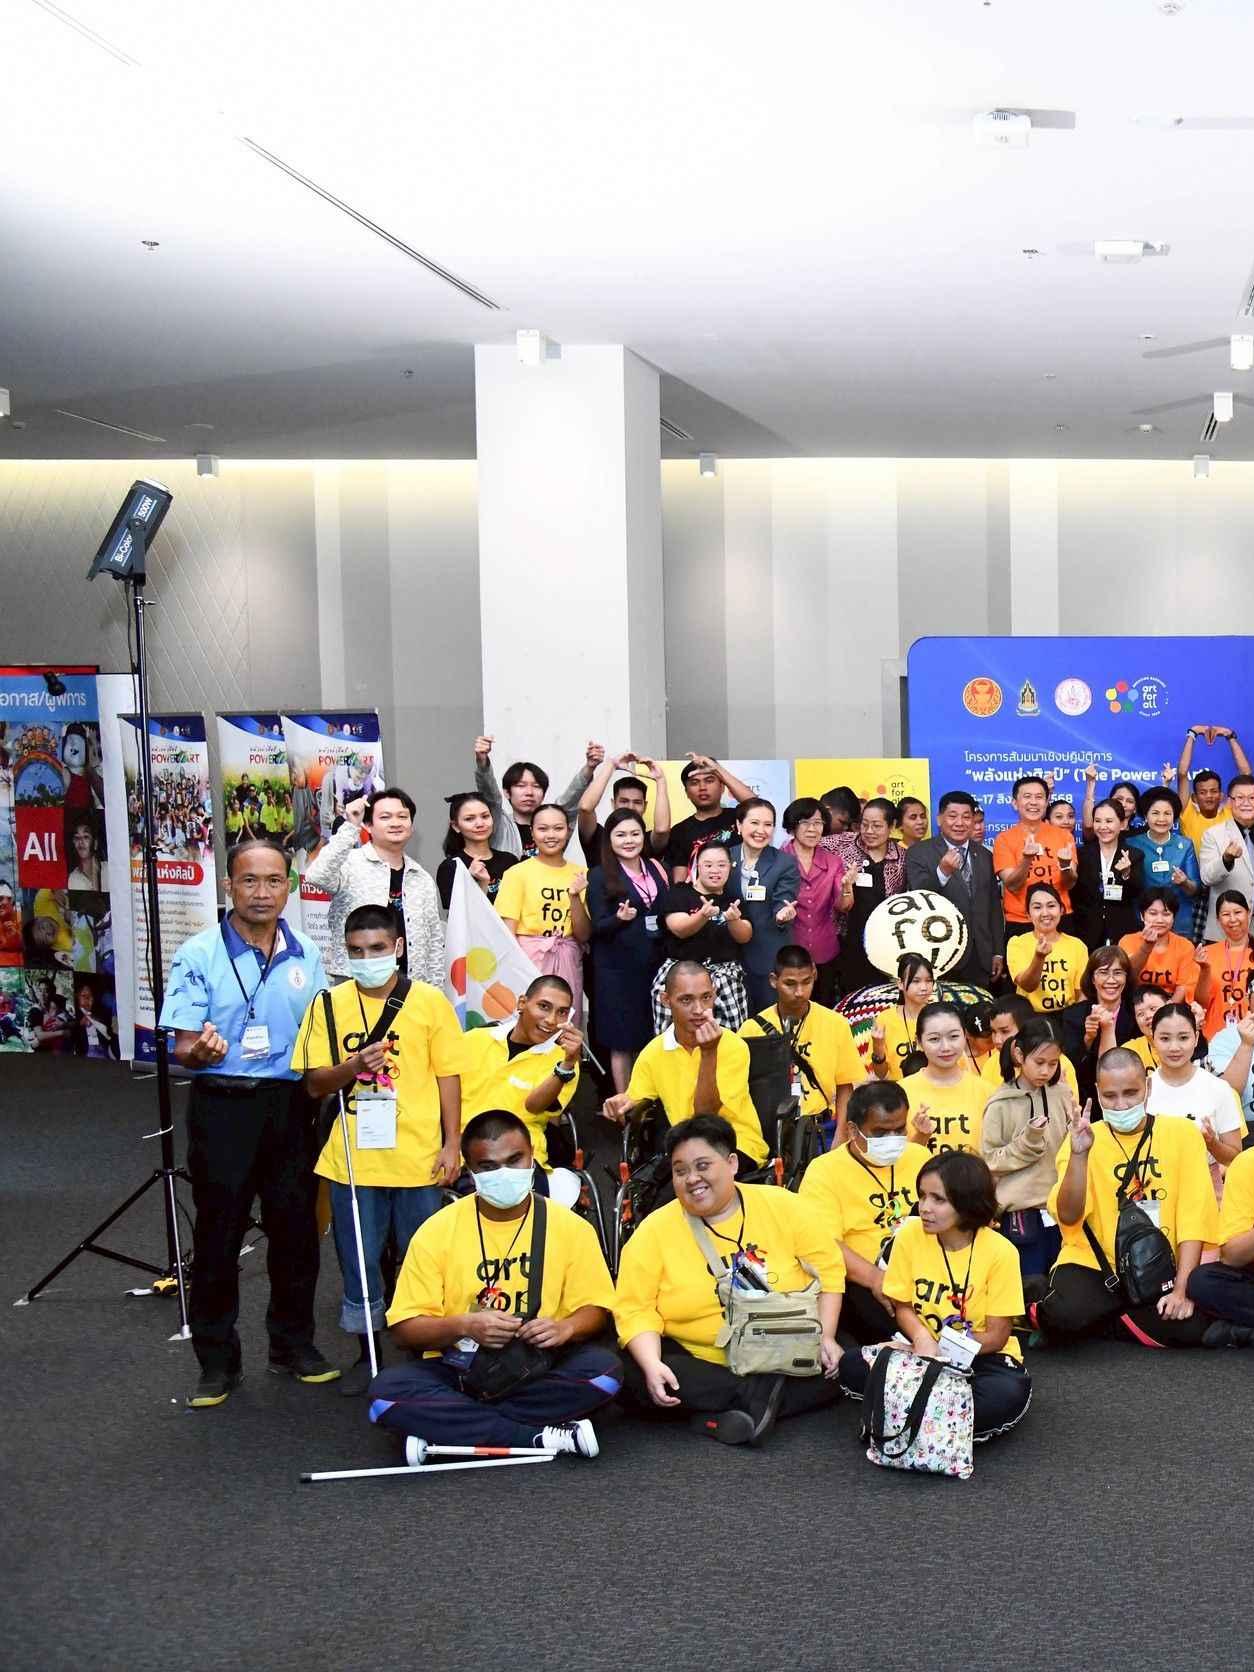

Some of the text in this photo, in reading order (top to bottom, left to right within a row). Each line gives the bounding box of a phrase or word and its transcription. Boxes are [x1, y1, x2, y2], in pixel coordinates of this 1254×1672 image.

[1142, 692, 1157, 701] for
[1111, 768, 1158, 781] Power
[23, 832, 58, 861] All
[541, 887, 570, 901] ar
[1140, 968, 1173, 984] art
[476, 1252, 531, 1282] art
